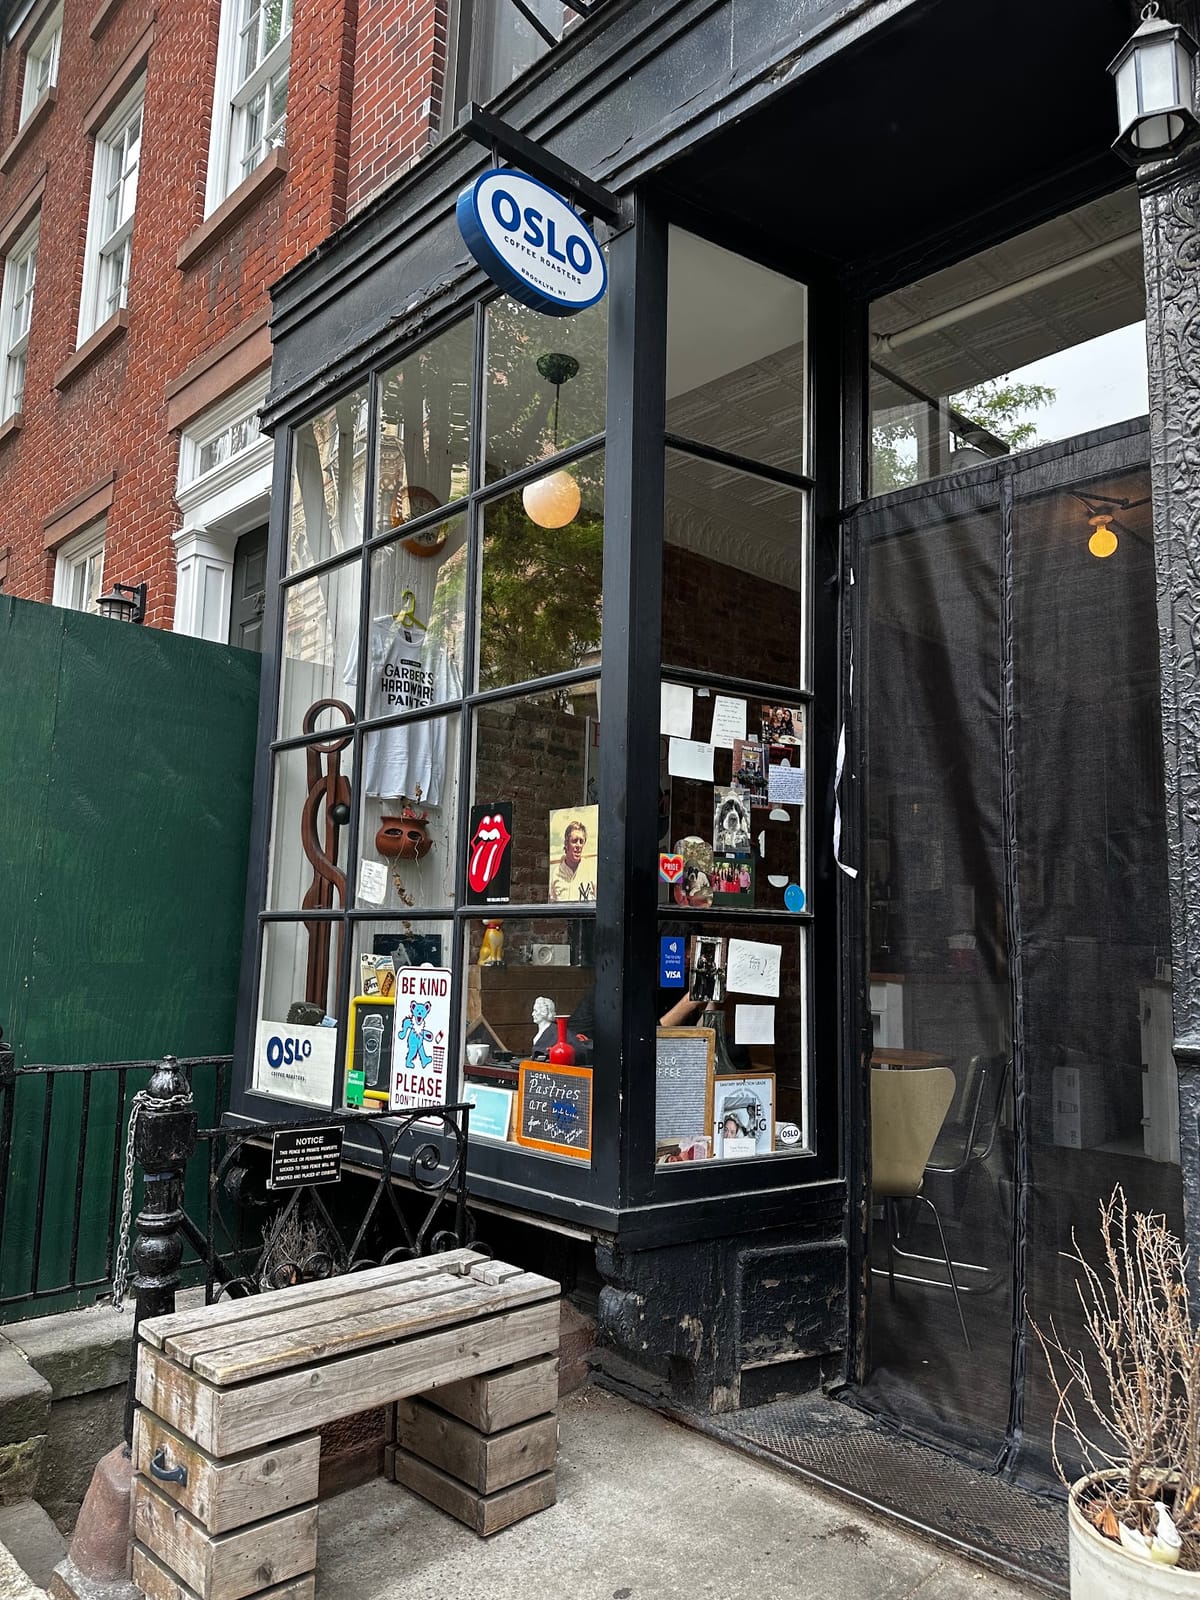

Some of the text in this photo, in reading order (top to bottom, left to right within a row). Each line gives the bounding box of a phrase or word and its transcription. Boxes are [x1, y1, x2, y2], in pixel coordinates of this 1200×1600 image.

[491, 189, 592, 275] OSLO
[504, 235, 582, 285] COFFEE ROASTERS
[521, 267, 557, 293] BROOKLYN,
[384, 663, 434, 686] GARBER'S
[381, 677, 434, 702] HARDWARE
[663, 862, 679, 871] PRIDE
[664, 970, 681, 979] VISA
[401, 976, 448, 997] BE KIND
[266, 1036, 312, 1069] OSLO
[657, 1056, 676, 1065] SLO
[530, 1071, 551, 1081] LOCAL
[658, 1067, 681, 1077] FFEE
[396, 1072, 443, 1099] PLEASE
[528, 1078, 581, 1101] Pastries
[395, 1093, 416, 1107] DON'T
[528, 1100, 548, 1112] are
[295, 1136, 324, 1146] NOTICE
[782, 1129, 799, 1138] OSLO
